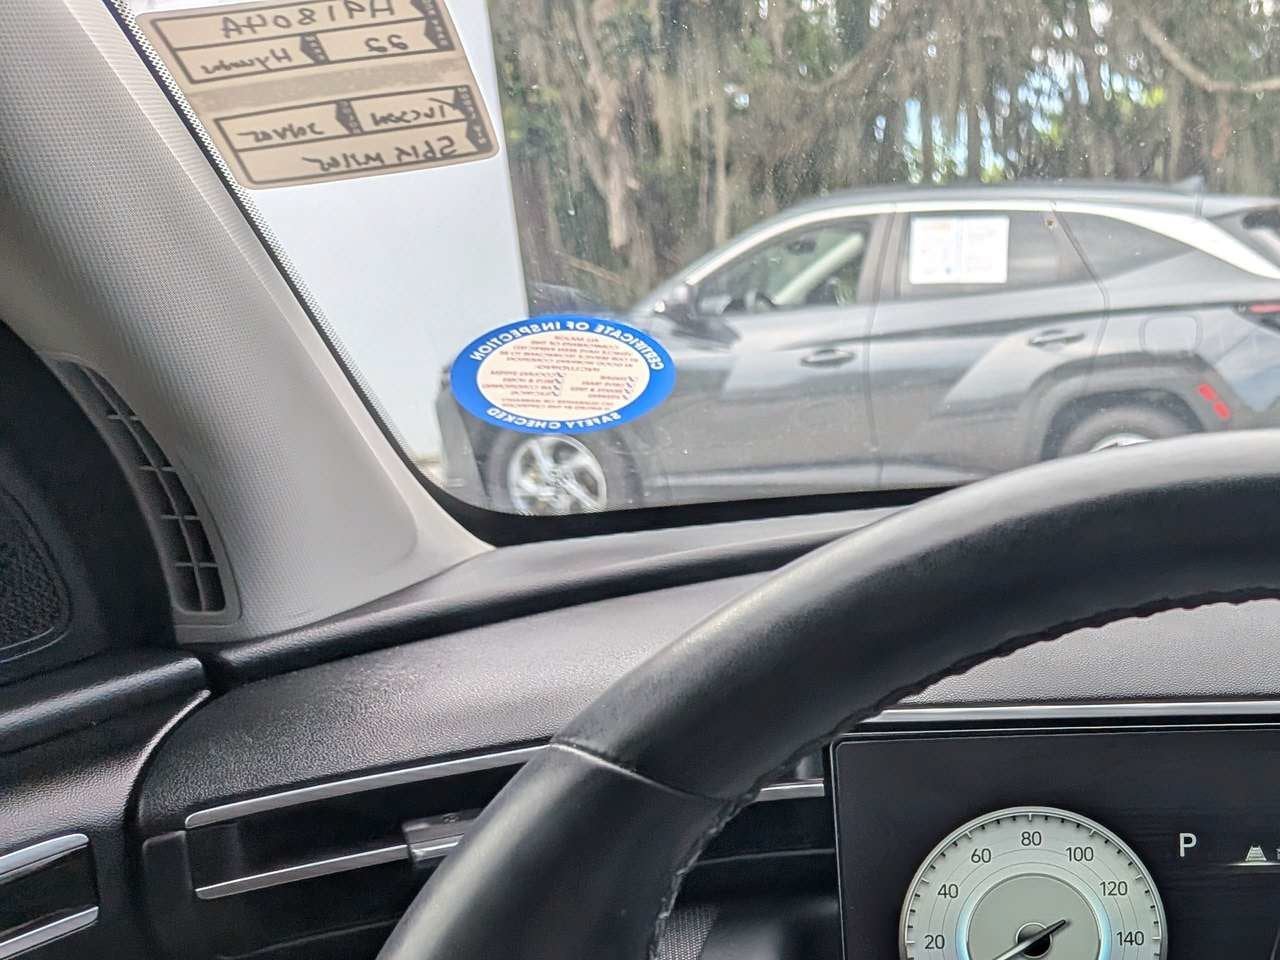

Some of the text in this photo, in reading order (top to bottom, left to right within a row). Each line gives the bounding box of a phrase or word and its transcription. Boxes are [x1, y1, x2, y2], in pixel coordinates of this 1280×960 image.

[1021, 831, 1042, 847] 80
[1179, 833, 1197, 857] P
[971, 848, 992, 864] 60
[1066, 847, 1094, 863] 100
[937, 883, 959, 899] 40
[1100, 881, 1128, 897] 120
[925, 934, 945, 950] 20
[1117, 931, 1145, 947] 140
